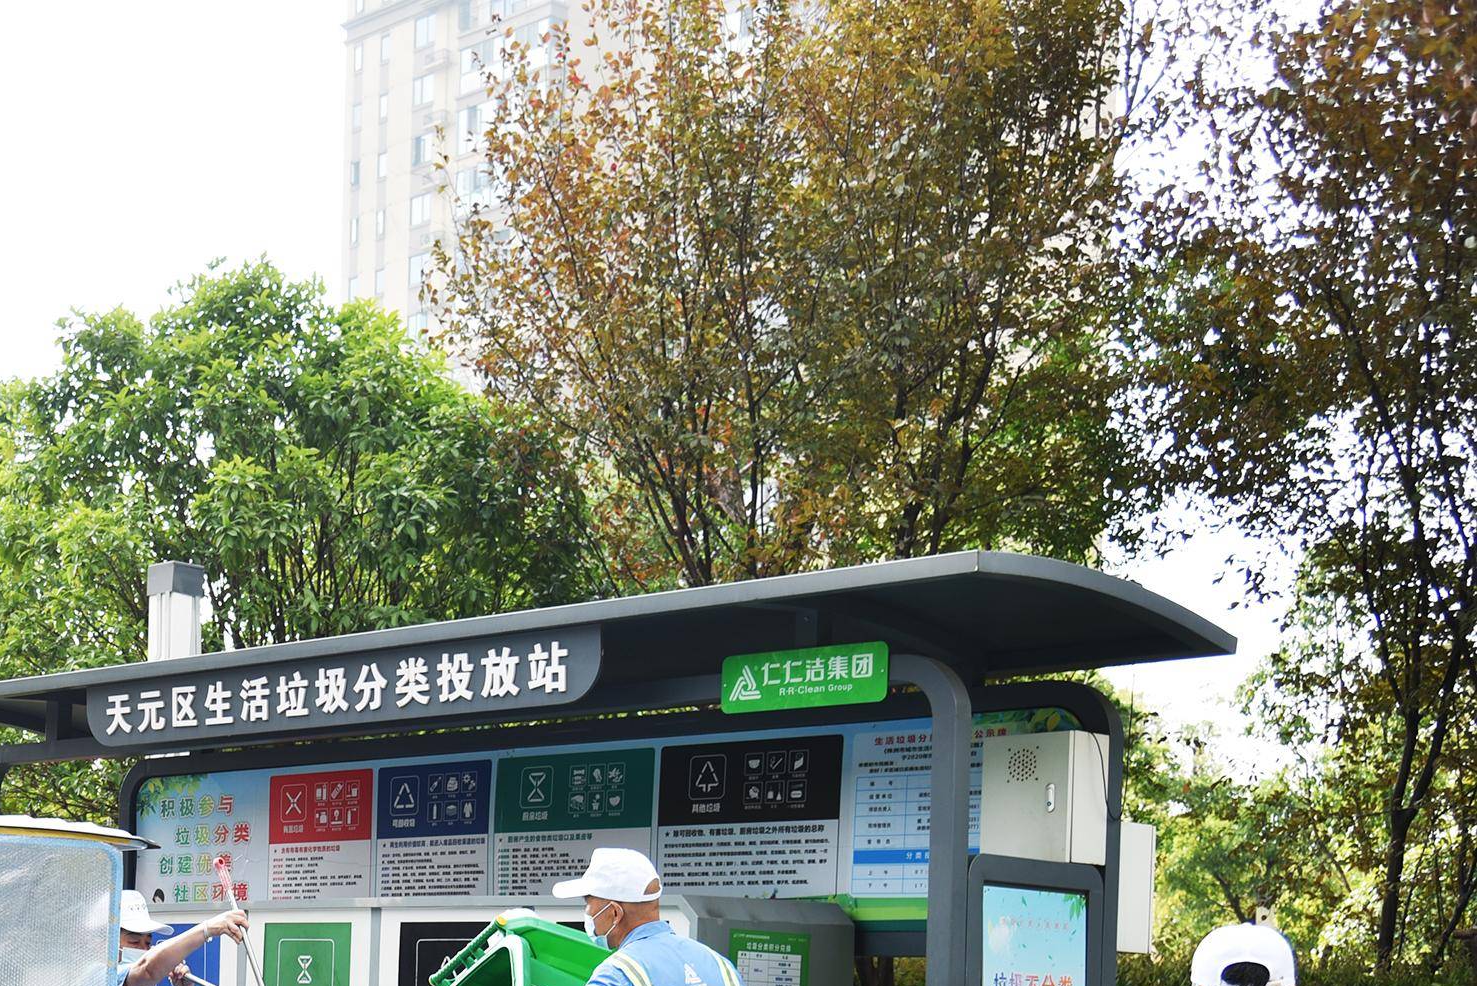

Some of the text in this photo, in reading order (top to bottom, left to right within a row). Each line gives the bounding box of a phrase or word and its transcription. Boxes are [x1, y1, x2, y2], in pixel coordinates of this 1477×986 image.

[760, 652, 874, 687] 仁仁洁集团
[105, 641, 570, 736] 天元区生活垃圾分类投放站
[827, 683, 853, 692] Group
[160, 795, 235, 819] 积极参与
[174, 823, 252, 848] 垃圾分类
